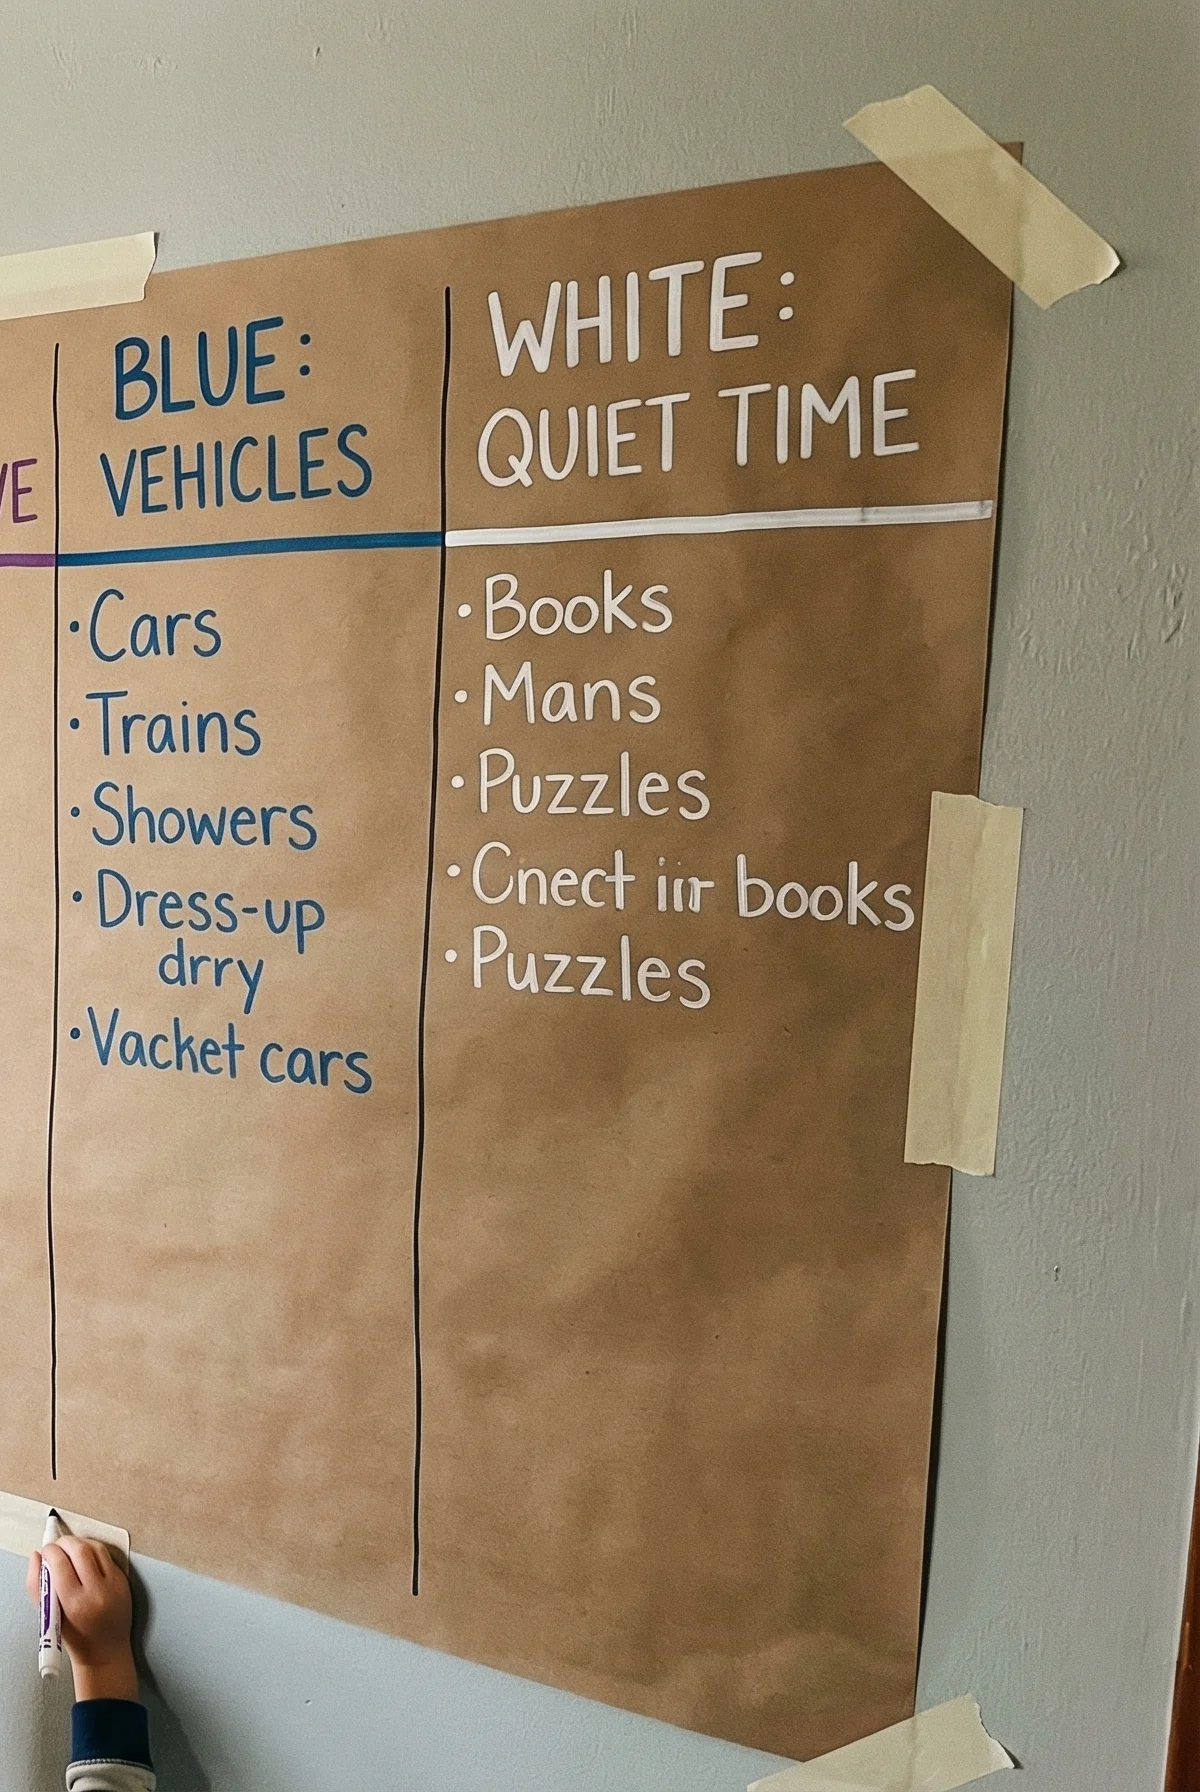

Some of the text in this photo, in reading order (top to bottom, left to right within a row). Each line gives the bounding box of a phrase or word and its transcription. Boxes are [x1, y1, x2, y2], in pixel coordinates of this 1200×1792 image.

[487, 251, 795, 378] WHITE:
[115, 316, 311, 421] BLUE:
[100, 423, 372, 517] VEHICLES
[477, 369, 920, 489] QUIET TIME
[90, 588, 222, 663] Cars
[484, 569, 674, 641] Books
[85, 690, 261, 757] Trains
[482, 661, 662, 726] Mans
[92, 781, 318, 851] Showers
[478, 747, 711, 821] Puzzles
[97, 868, 326, 955] Dress-up
[471, 841, 636, 910] Cnect
[736, 853, 915, 932] books
[158, 937, 264, 1015] drry
[472, 924, 712, 1010] Puzzles
[87, 1006, 373, 1095] Vacket cars
